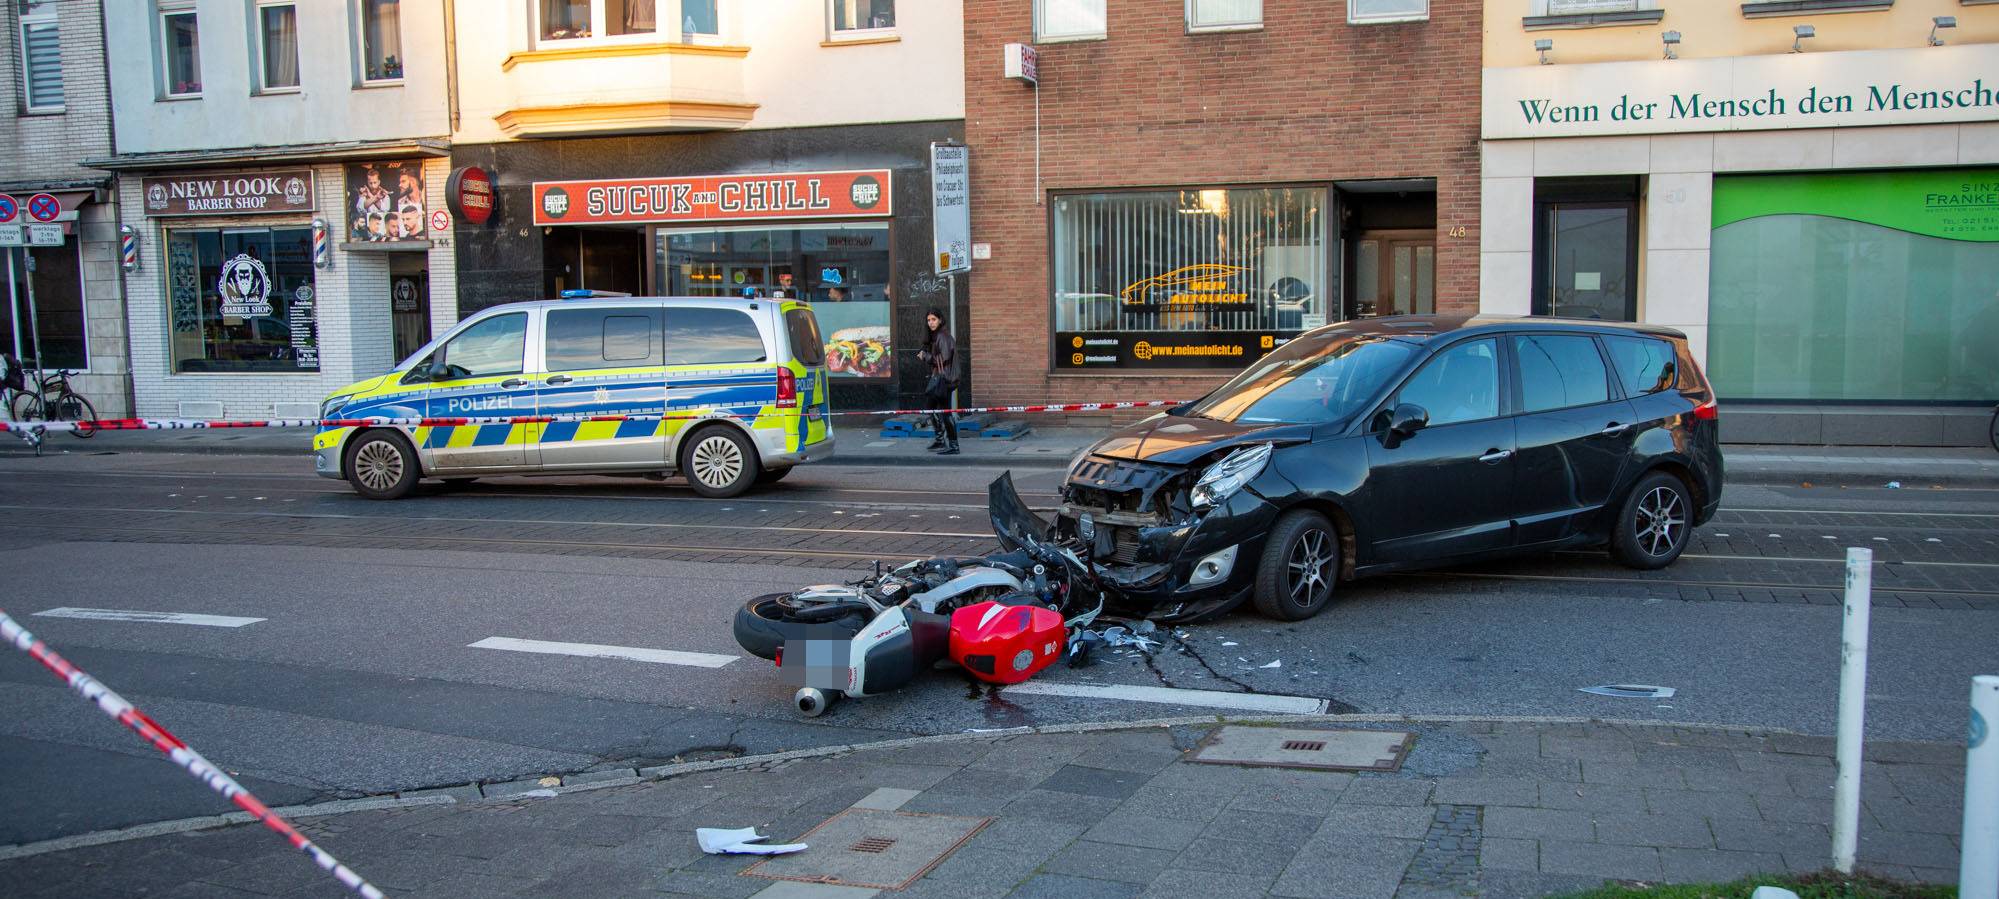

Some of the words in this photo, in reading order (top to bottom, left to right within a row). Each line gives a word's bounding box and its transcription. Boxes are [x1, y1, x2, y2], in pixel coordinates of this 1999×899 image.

[1518, 99, 1600, 125] Wenn
[1611, 94, 1657, 121] der
[1668, 89, 1786, 119] Mensch
[1798, 86, 1853, 114] den
[1865, 78, 1999, 111] Mensch
[170, 180, 218, 199] NEW
[223, 177, 283, 197] LOOK
[852, 183, 878, 192] SUCUK
[587, 184, 692, 216] SUCUK
[692, 192, 717, 204] AND
[718, 179, 830, 212] CHILL
[852, 191, 879, 201] CHILL
[1926, 193, 1999, 205] FRANKE
[188, 197, 233, 211] BARBER
[236, 196, 267, 209] SHOP
[519, 228, 529, 237] 46
[1449, 226, 1467, 238] 48
[1190, 281, 1227, 291] MEIN
[245, 295, 260, 303] Look
[1171, 293, 1248, 304] AUTOLICHT
[224, 306, 251, 314] BARBER
[252, 305, 270, 313] SHOP
[1152, 344, 1243, 357] www.meinautolicht.de
[449, 395, 513, 413] POLIZEI
